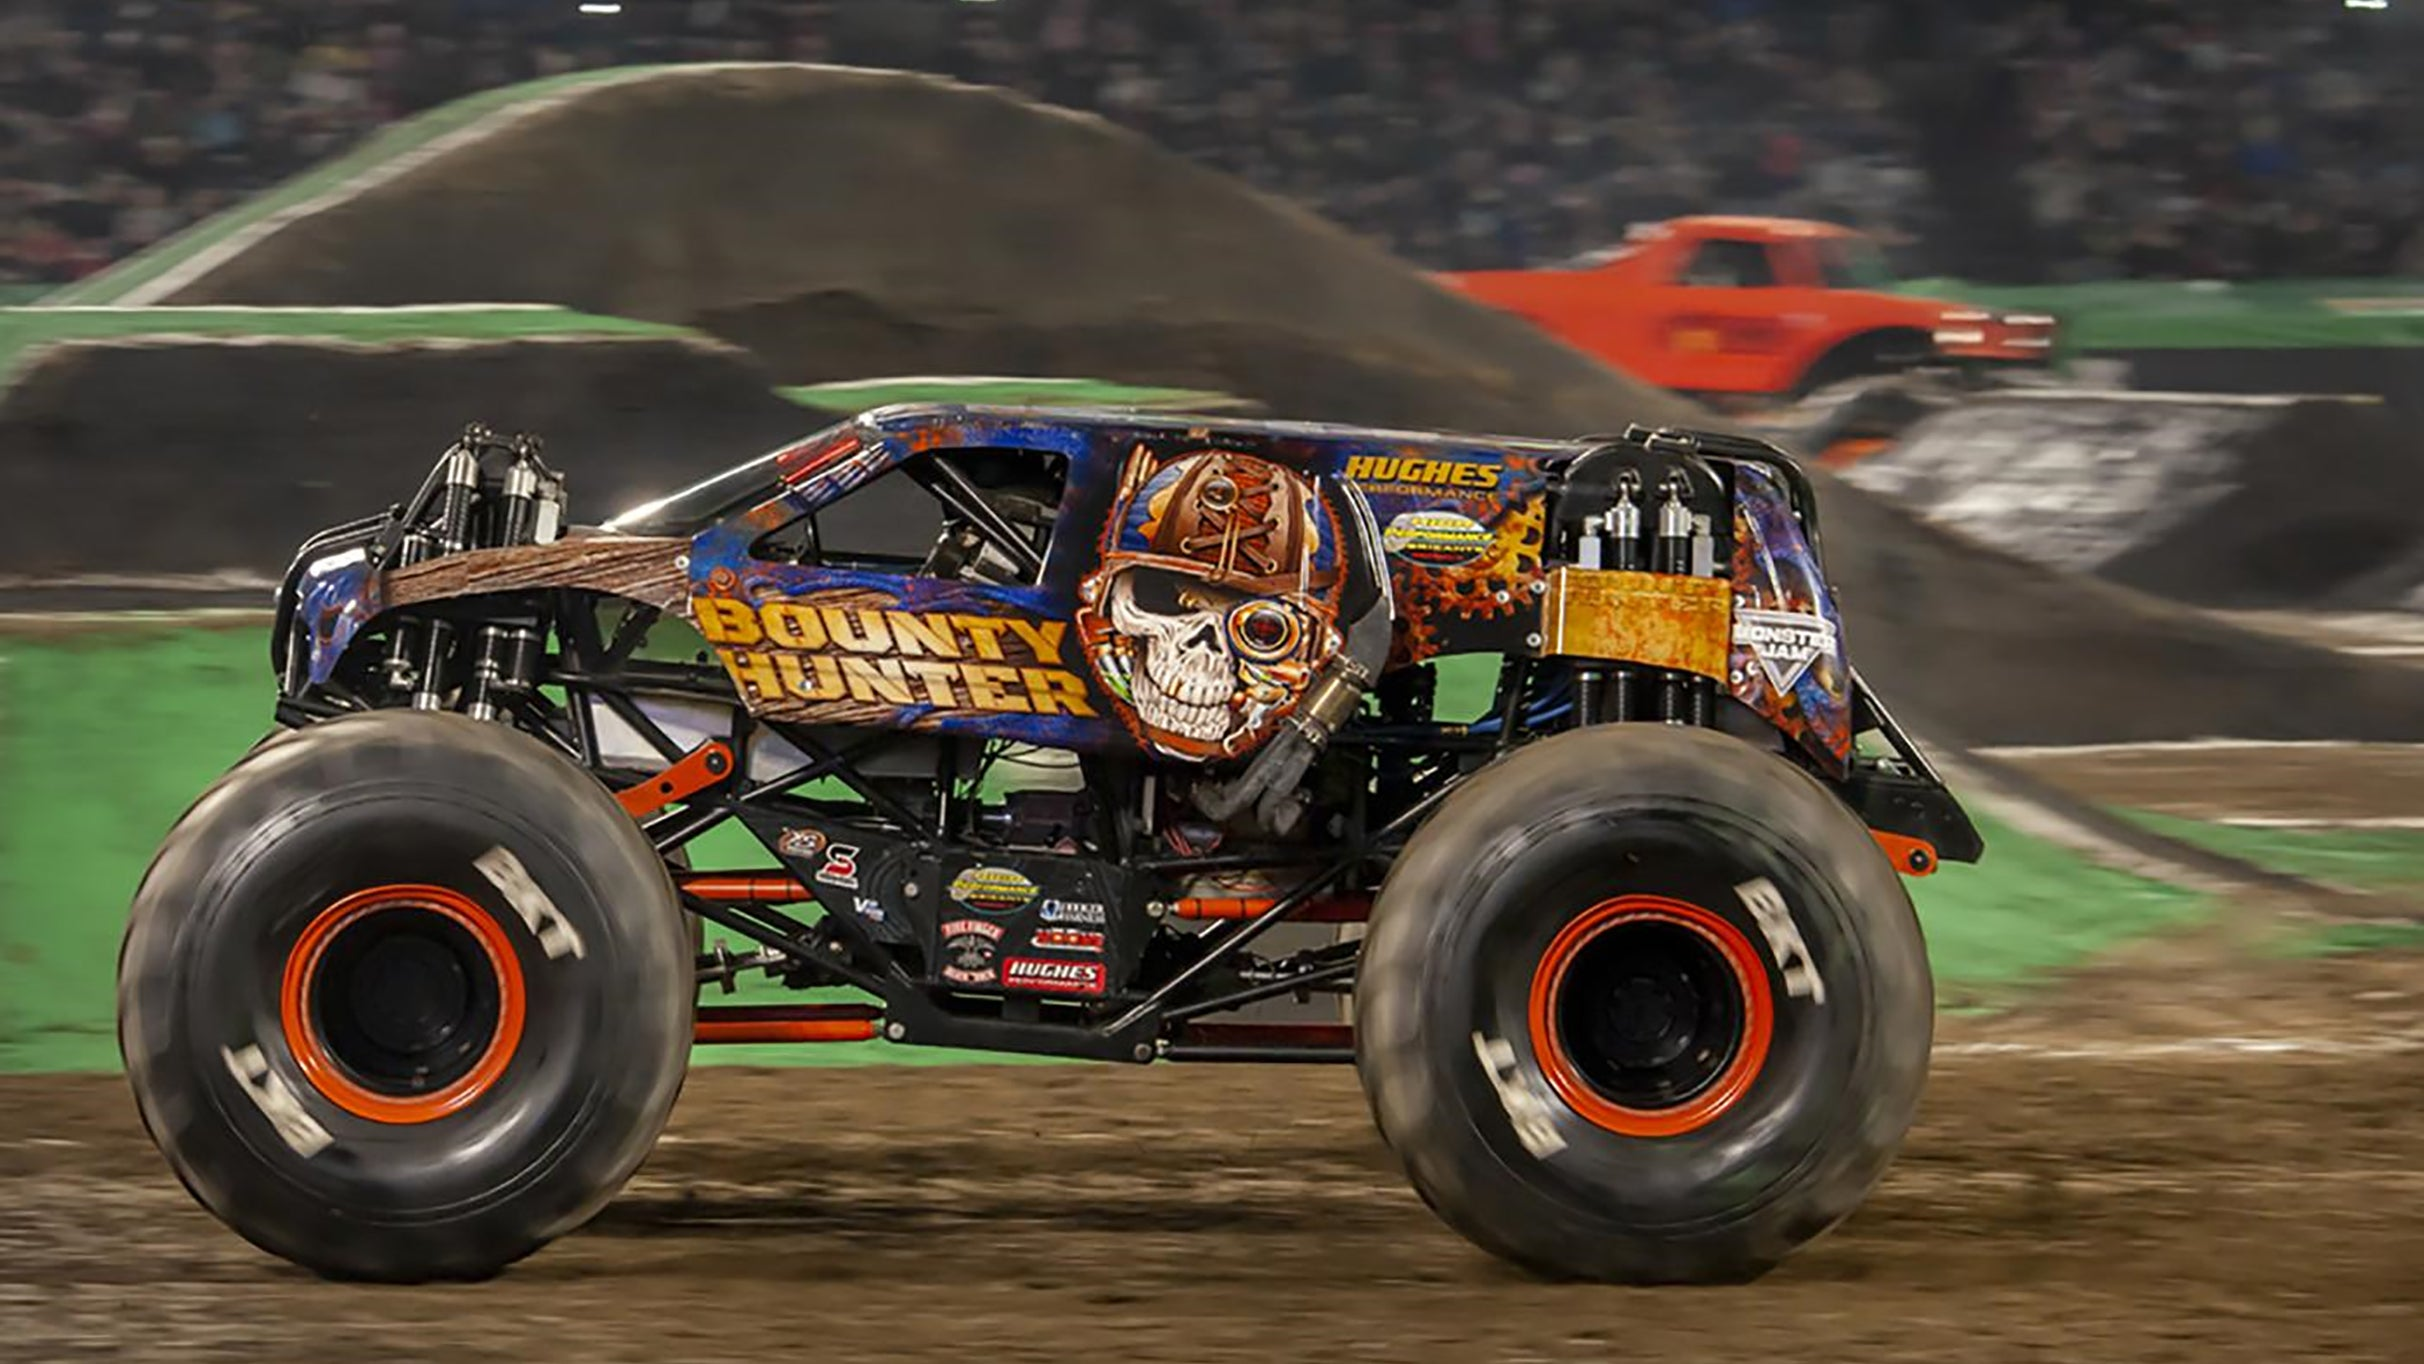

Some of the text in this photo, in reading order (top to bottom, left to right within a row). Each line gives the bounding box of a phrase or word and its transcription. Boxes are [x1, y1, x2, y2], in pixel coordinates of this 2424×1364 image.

[1345, 455, 1503, 488] HUGHES
[692, 598, 1067, 664] BOUNTY
[1761, 641, 1815, 661] JAM
[716, 648, 1098, 717] HUNTER
[472, 845, 587, 960] BKT
[1009, 960, 1098, 981] HUGHES
[1733, 876, 1826, 1004] BKT
[220, 1044, 336, 1158] BKT
[1472, 1031, 1569, 1160] BKT
